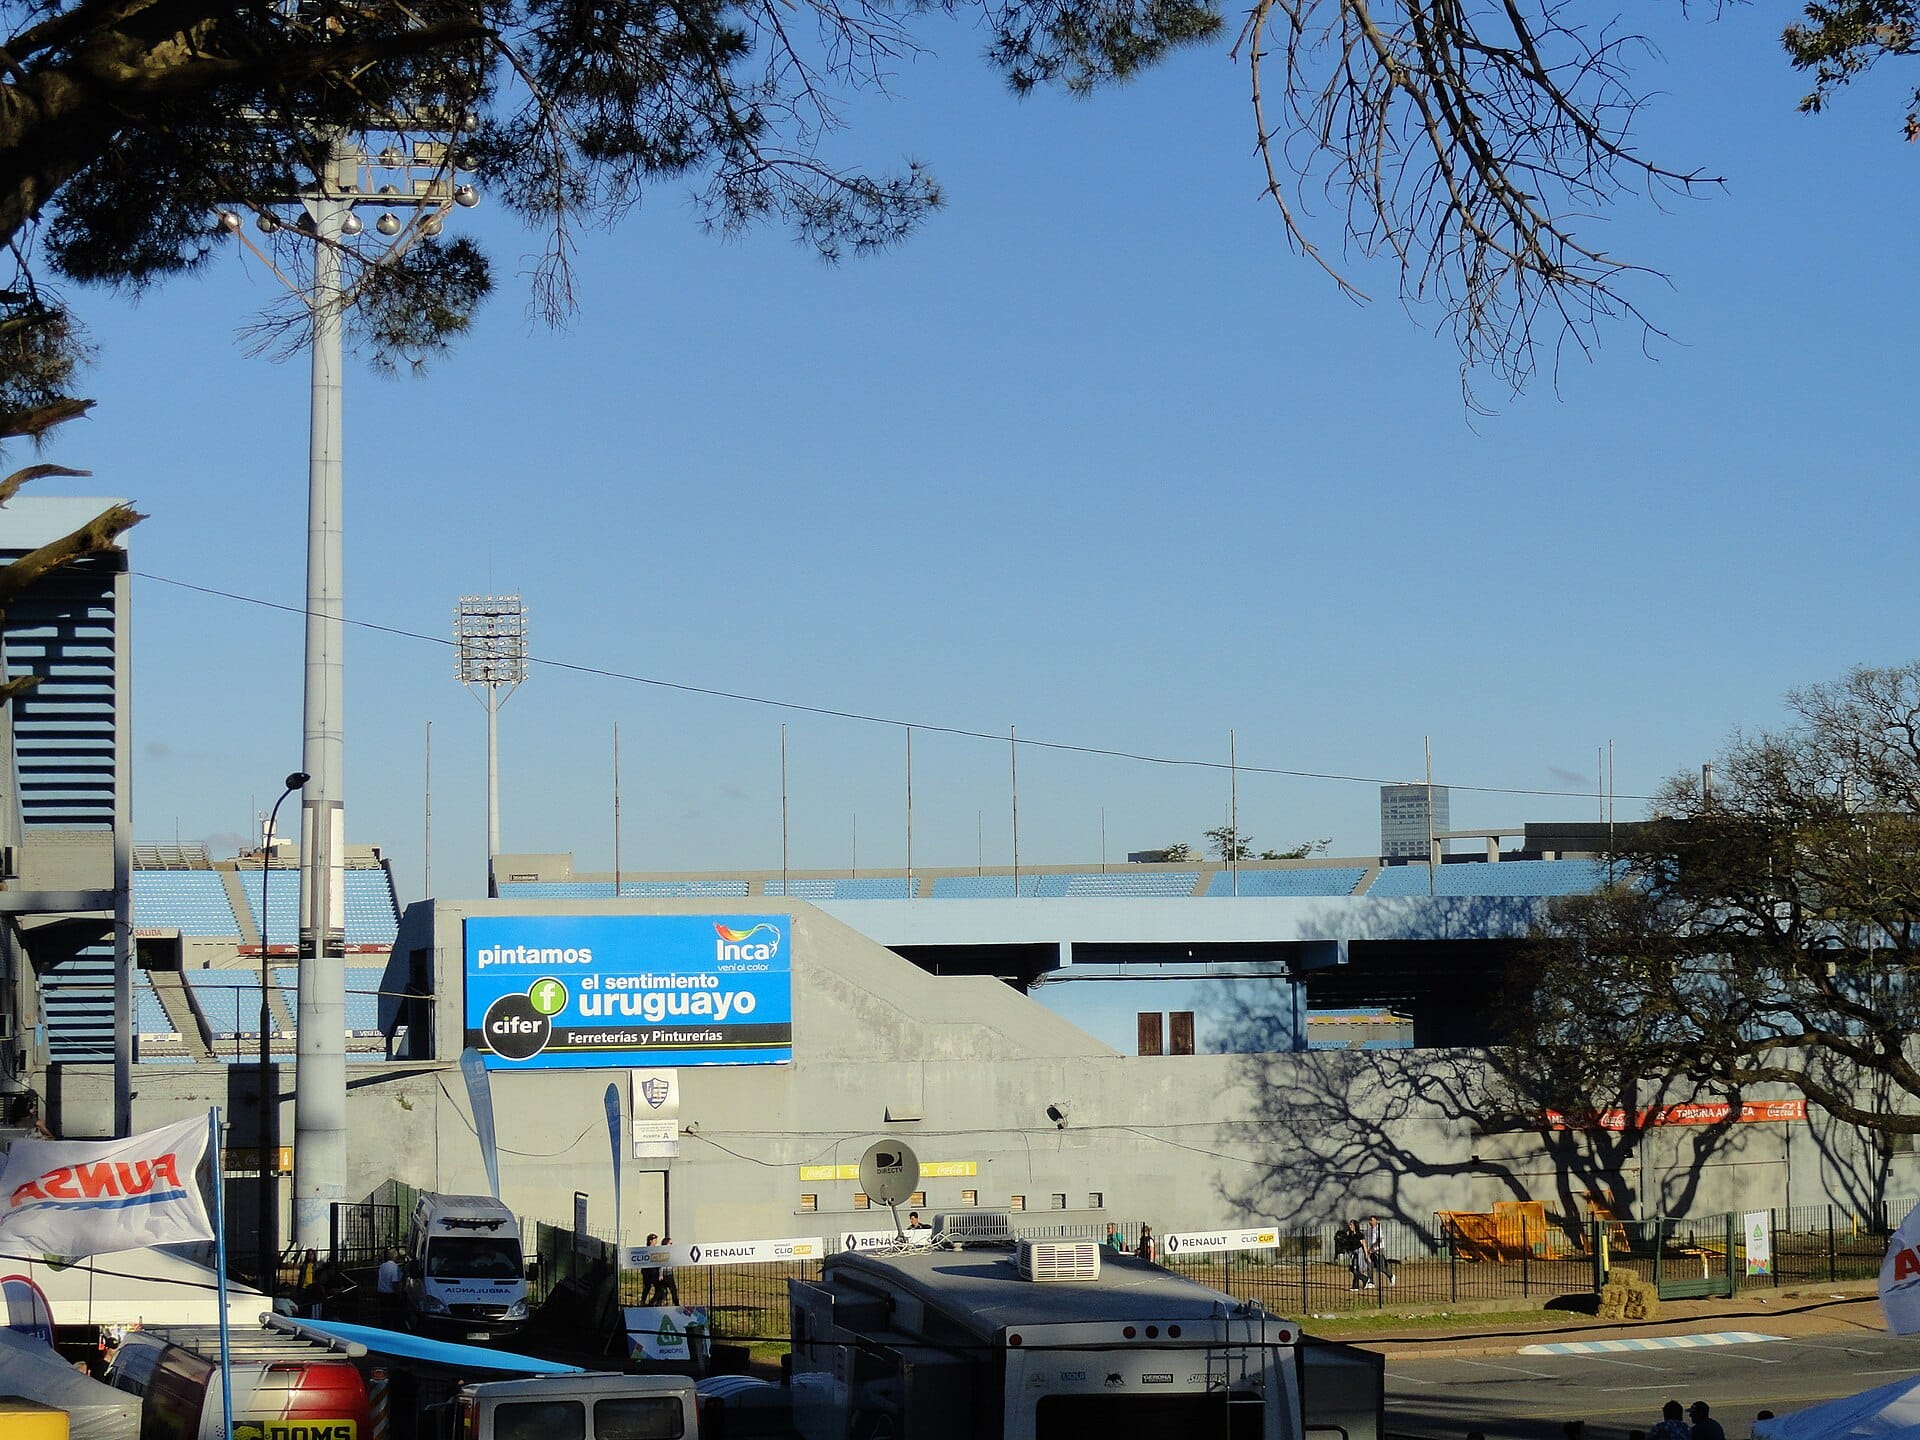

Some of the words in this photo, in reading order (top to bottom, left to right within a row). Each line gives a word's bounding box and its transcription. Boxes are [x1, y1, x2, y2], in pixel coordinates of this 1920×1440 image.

[135, 929, 162, 937] SALIDA
[717, 939, 769, 961] Inca
[478, 945, 592, 969] pintamos
[746, 963, 769, 971] color
[581, 974, 599, 990] el
[605, 974, 719, 990] sentimiento
[579, 990, 756, 1022] uruguayo
[492, 1016, 543, 1034] cifer
[568, 1030, 638, 1044] Ferreterías
[640, 1034, 649, 1045] y
[652, 1029, 723, 1043] Pinturerías
[1716, 1106, 1754, 1117] AMCA
[662, 1132, 670, 1140] A
[1182, 1237, 1228, 1247] RENAULT
[705, 1247, 756, 1258] RENAULT
[774, 1247, 793, 1255] CLIO
[794, 1246, 811, 1254] CUP
[631, 1254, 650, 1262] CLIO
